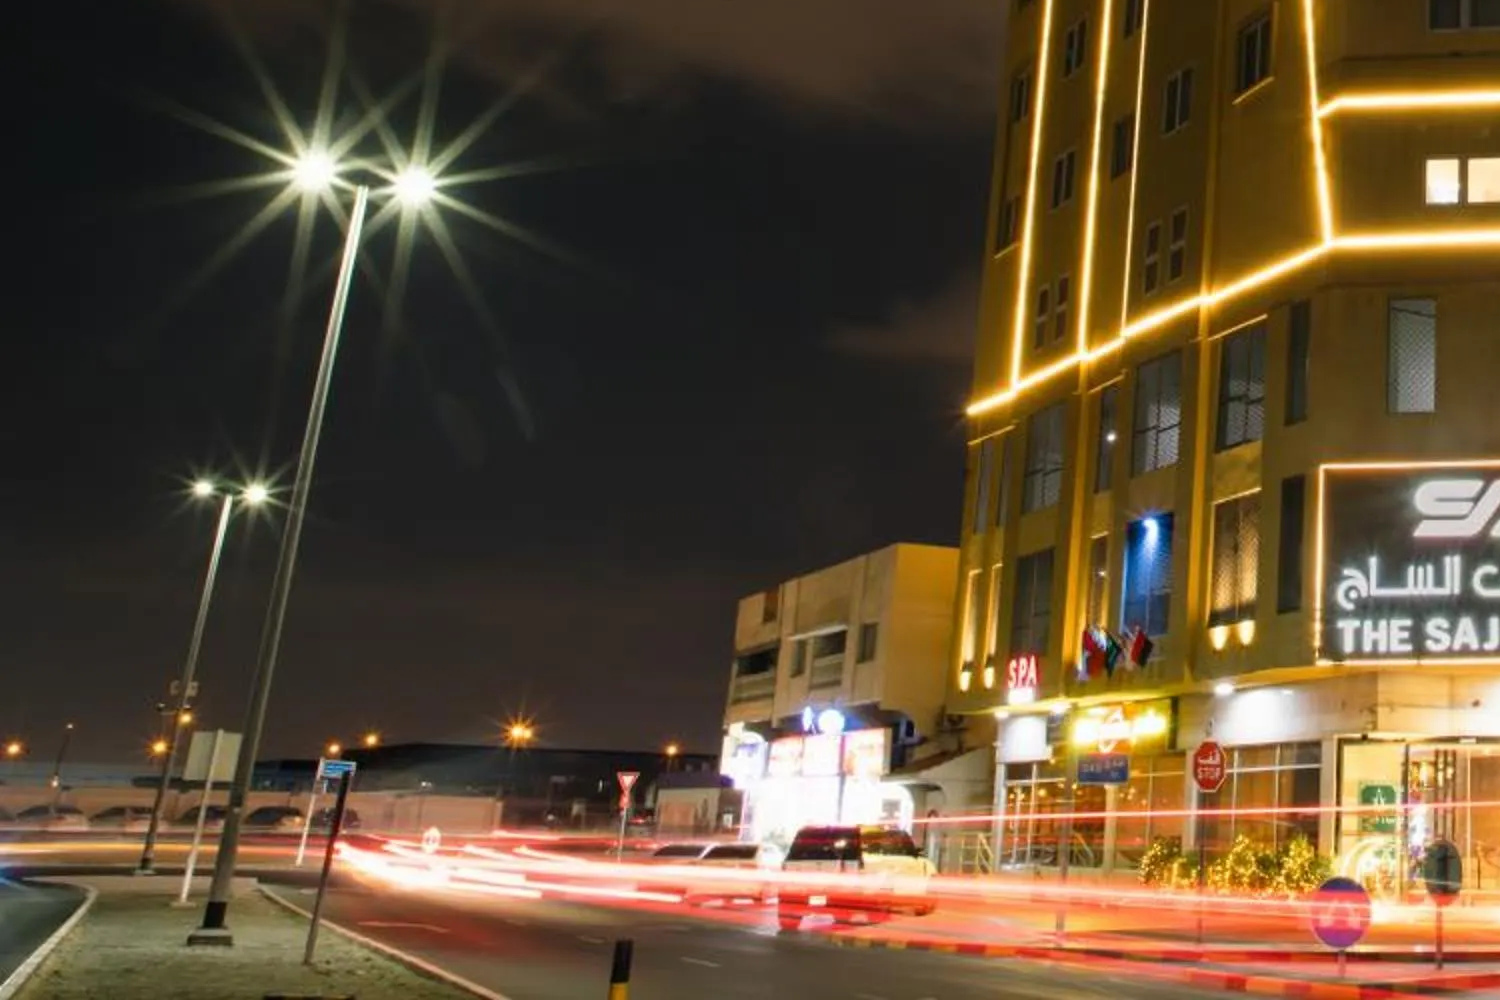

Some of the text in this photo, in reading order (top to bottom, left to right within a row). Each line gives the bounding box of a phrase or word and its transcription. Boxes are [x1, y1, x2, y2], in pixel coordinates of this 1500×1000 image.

[1337, 618, 1413, 654] THE
[1425, 615, 1500, 652] SAJ
[1007, 655, 1038, 688] SPA
[1197, 767, 1221, 780] STOP
